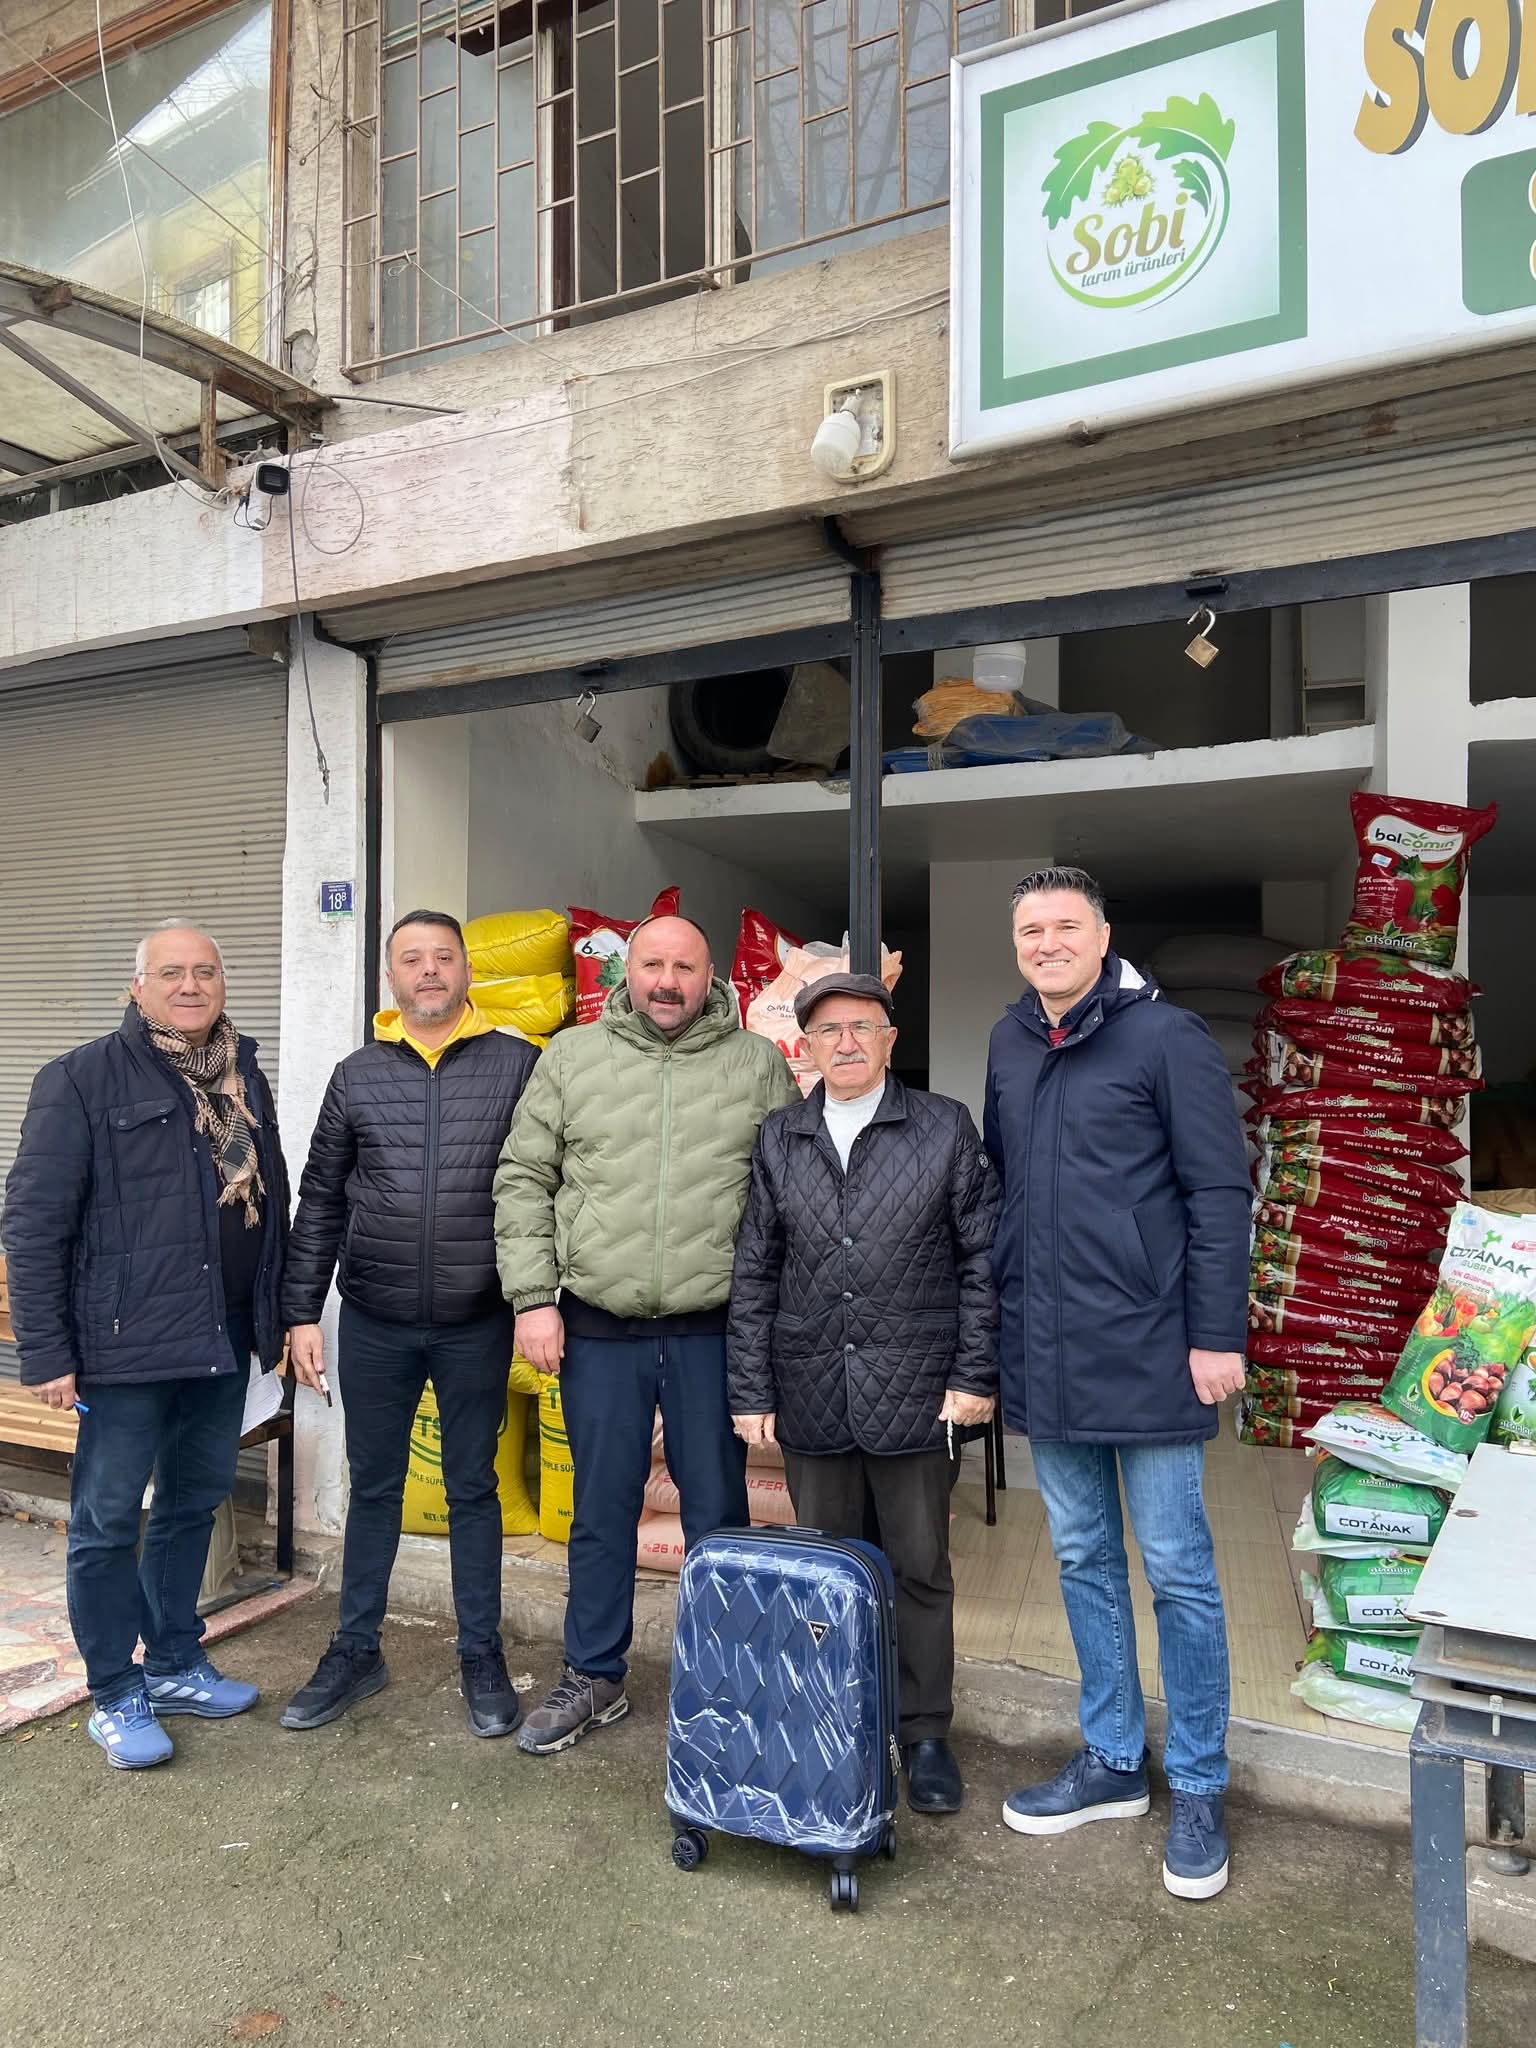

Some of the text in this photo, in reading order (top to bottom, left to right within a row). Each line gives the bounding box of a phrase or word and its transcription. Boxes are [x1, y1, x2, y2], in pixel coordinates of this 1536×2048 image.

[1354, 0, 1536, 156] SO
[1066, 191, 1189, 275] Sobi
[1081, 247, 1186, 288] tarım ürünleri
[1364, 934, 1419, 949] atsanlar
[1339, 1517, 1412, 1535] COTANAK
[1362, 1608, 1407, 1616] COTA
[1359, 1658, 1416, 1678] COTAN
